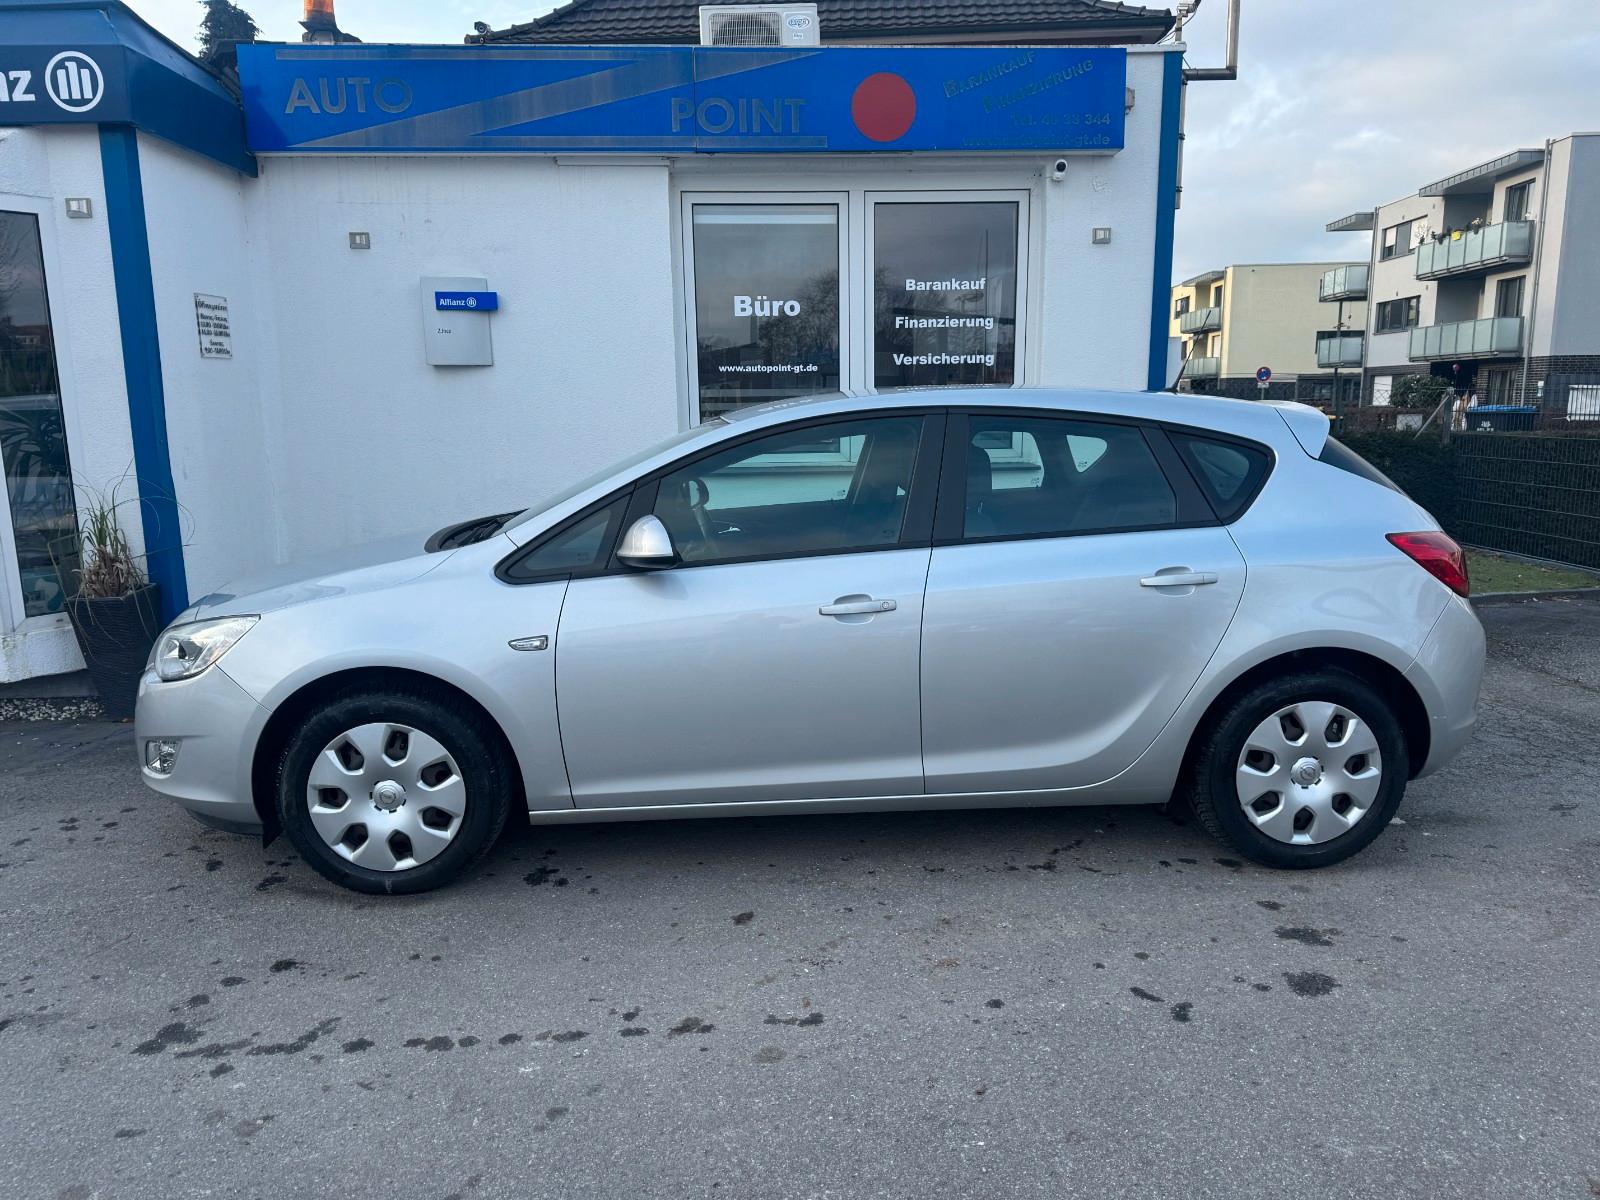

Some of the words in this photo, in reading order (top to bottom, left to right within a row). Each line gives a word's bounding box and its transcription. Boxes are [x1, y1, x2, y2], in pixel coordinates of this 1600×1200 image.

[284, 77, 413, 114] AUTO
[671, 97, 807, 134] POINT
[1084, 112, 1111, 125] 344
[905, 278, 986, 291] Barankauf
[440, 298, 466, 306] Allianz
[734, 295, 801, 317] Büro
[895, 316, 994, 329] Finanzierung
[892, 353, 995, 366] Versicherung
[718, 363, 818, 374] www.autopoint-gt.de
